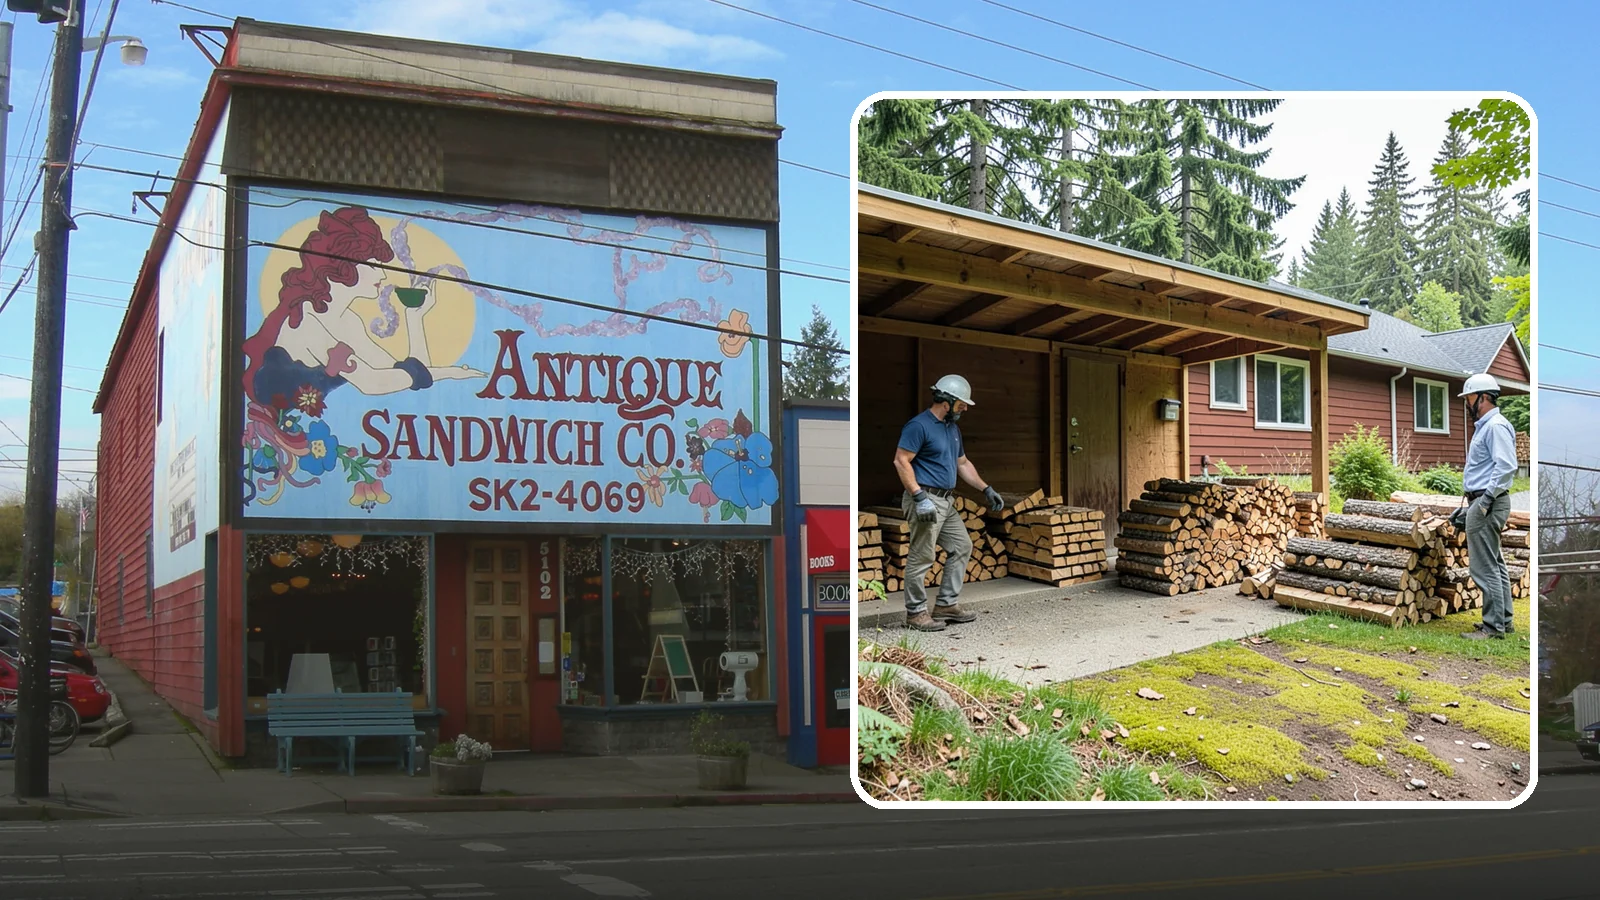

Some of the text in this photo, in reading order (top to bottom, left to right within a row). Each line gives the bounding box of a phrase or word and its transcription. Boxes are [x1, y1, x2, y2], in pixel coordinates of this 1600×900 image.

[477, 330, 724, 420] ANTIQUE
[362, 409, 684, 469] SANDWICH CO.
[469, 477, 645, 513] SK2-4069
[540, 542, 551, 599] 5102
[809, 555, 834, 569] BOOKS
